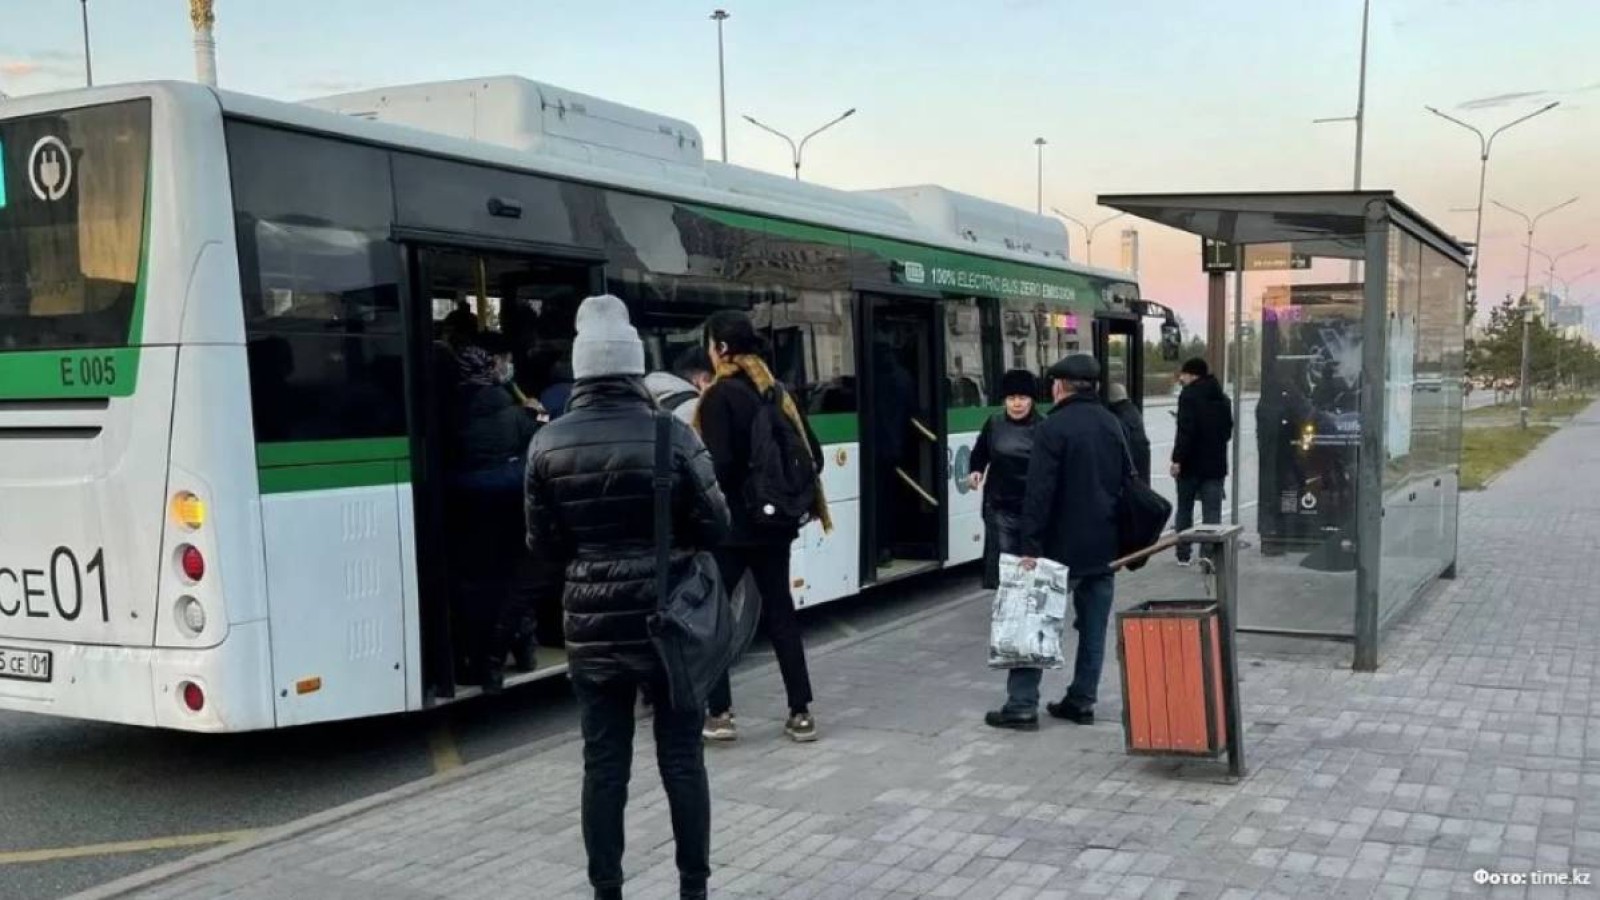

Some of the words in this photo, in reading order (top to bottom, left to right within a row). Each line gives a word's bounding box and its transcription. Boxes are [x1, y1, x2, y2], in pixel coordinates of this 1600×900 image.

[932, 267, 956, 286] 100%
[957, 270, 1000, 291] ELECTRIC
[1002, 277, 1019, 294] BUS
[1020, 280, 1041, 297] ZERO
[1042, 283, 1076, 300] EMISSION
[61, 357, 74, 386] E
[80, 356, 116, 386] 005
[10, 656, 25, 673] CE
[31, 654, 48, 675] 01
